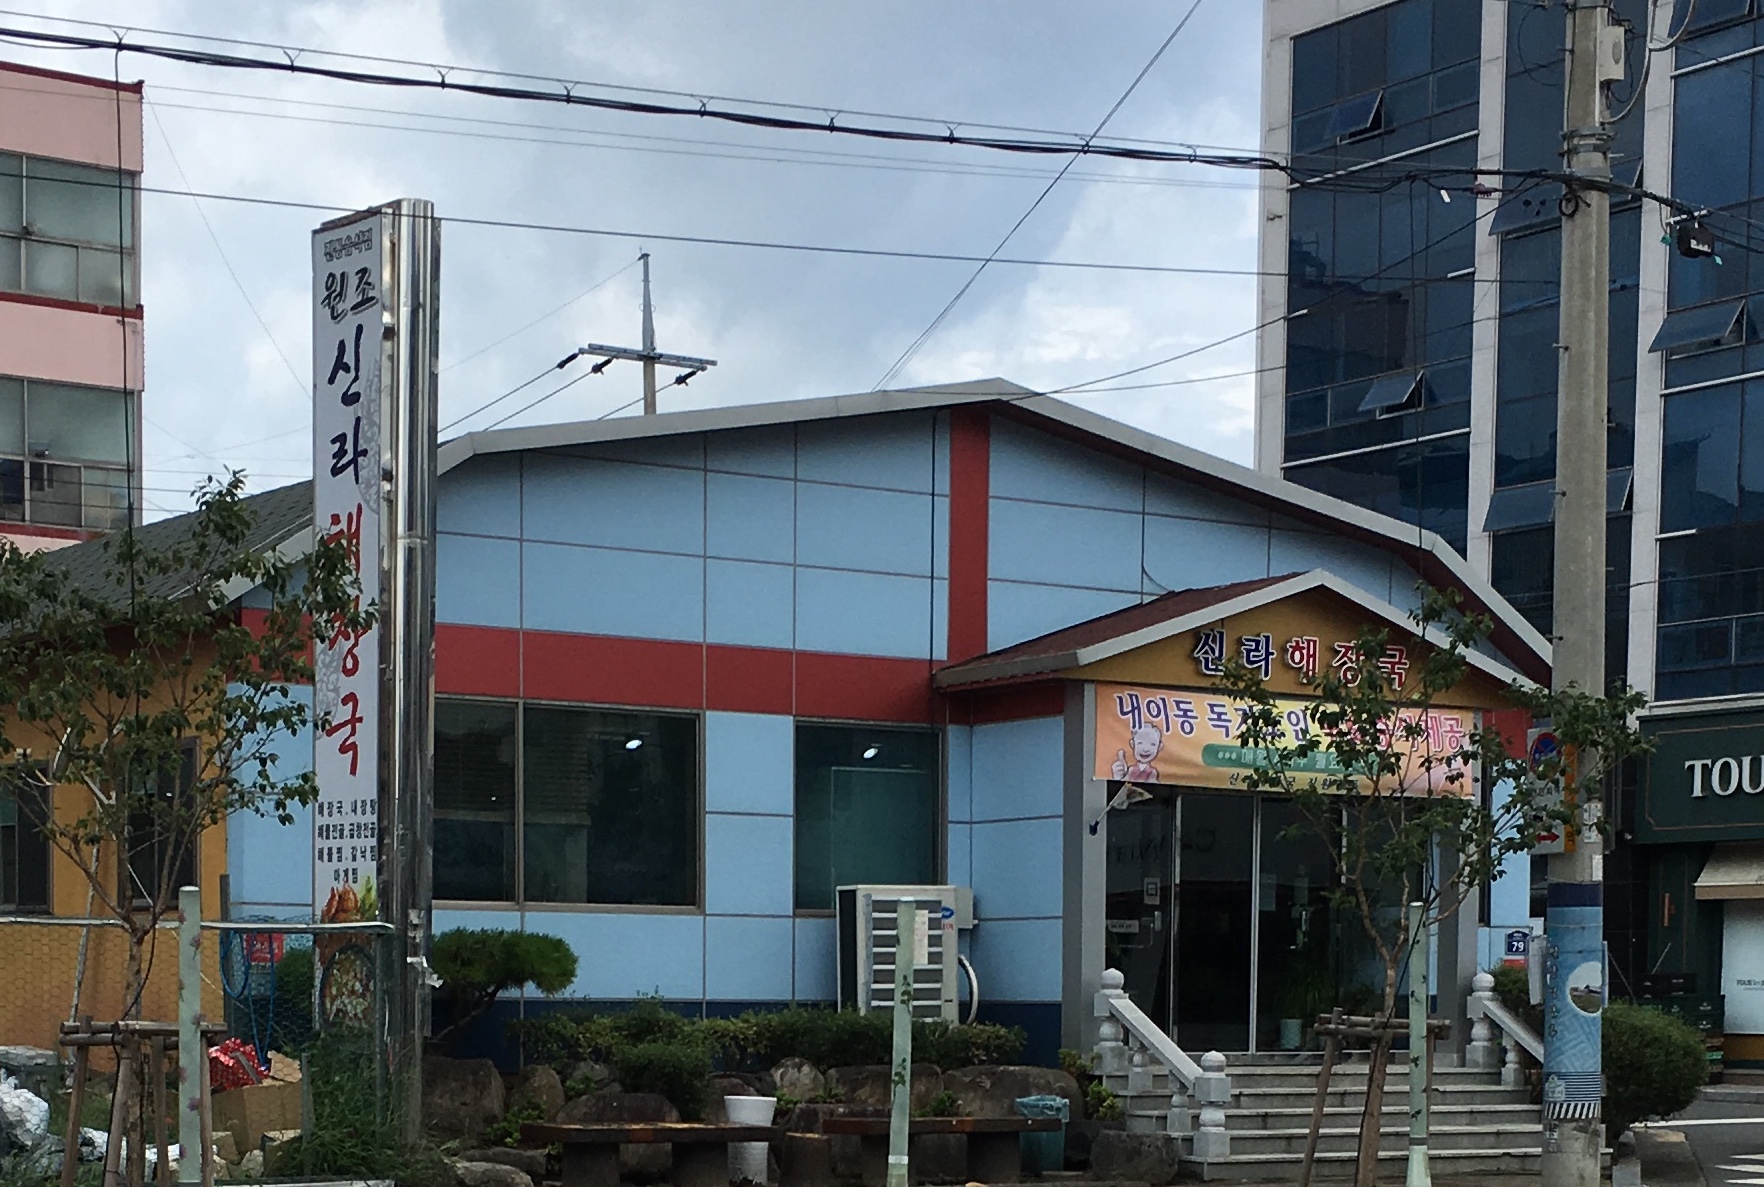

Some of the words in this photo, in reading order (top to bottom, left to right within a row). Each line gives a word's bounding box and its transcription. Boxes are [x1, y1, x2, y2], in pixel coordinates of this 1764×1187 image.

[321, 266, 379, 323] 원조
[1194, 630, 1410, 690] 신라해장국
[1116, 692, 1199, 739] 내이동
[1511, 941, 1525, 952] 79
